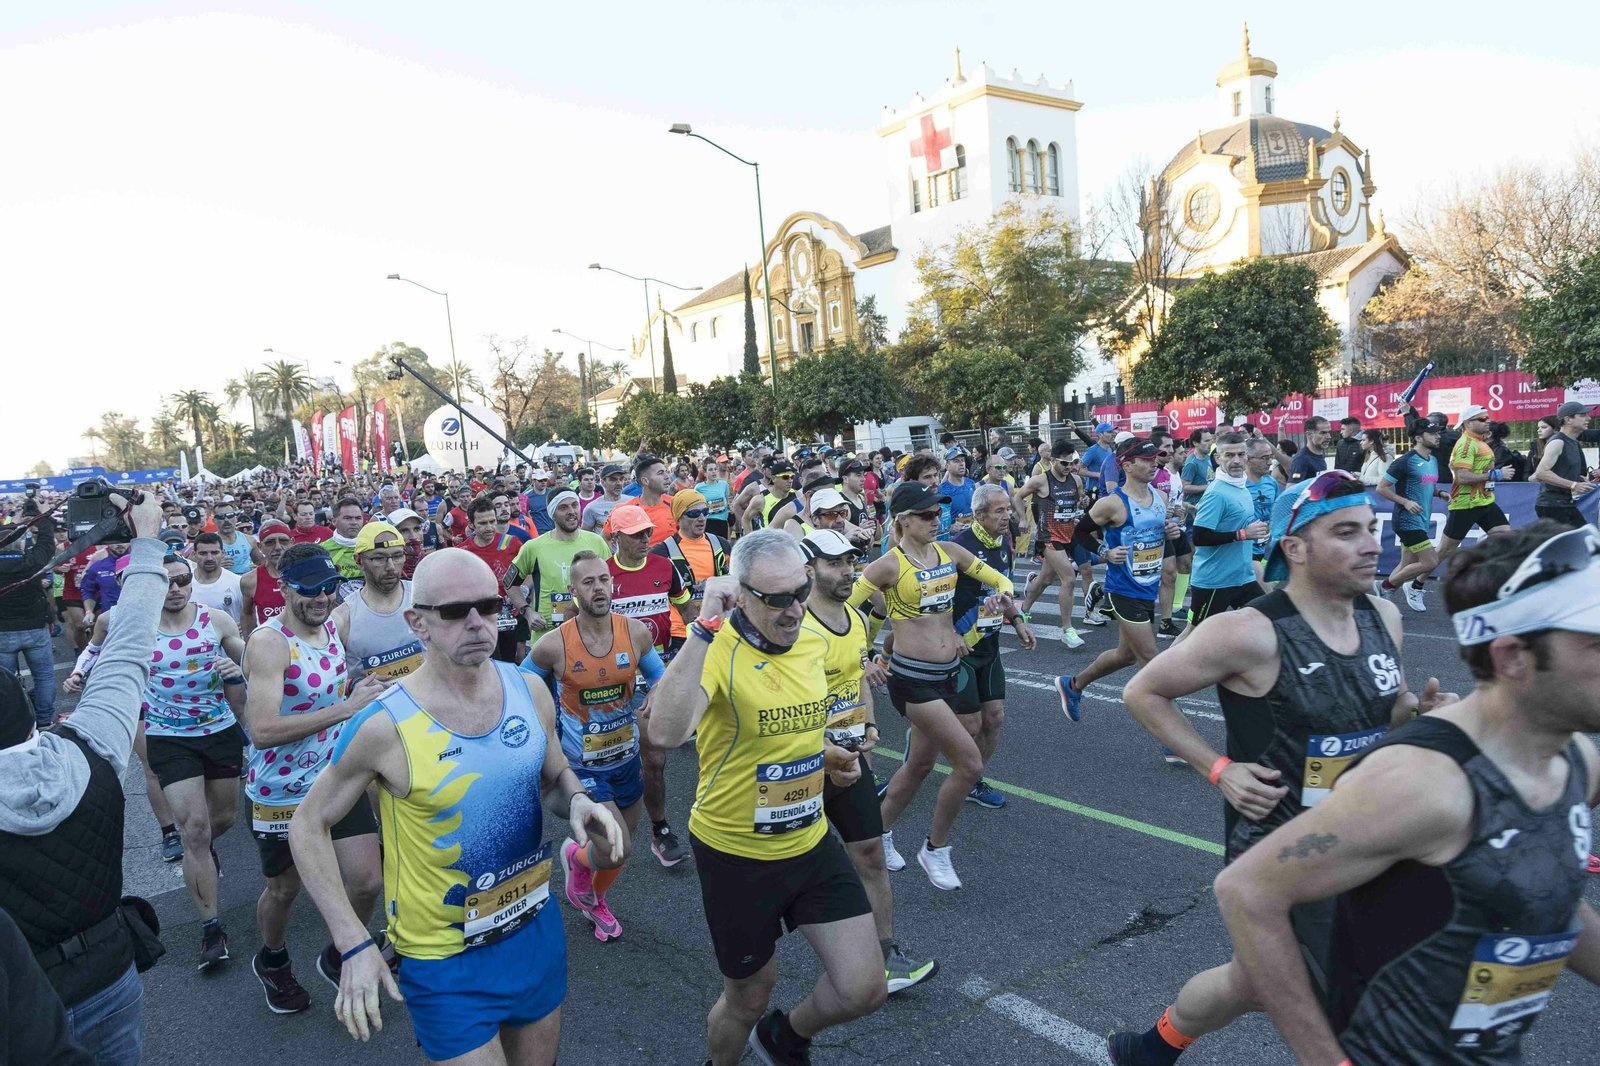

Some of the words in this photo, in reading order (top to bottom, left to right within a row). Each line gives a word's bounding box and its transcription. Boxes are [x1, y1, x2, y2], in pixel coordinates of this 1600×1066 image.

[1188, 407, 1207, 418] IMD
[431, 441, 479, 450] ZURICH
[382, 646, 414, 663] ZURICH
[583, 686, 622, 700] Genacol
[758, 700, 830, 722] RUNNERS
[602, 717, 628, 731] ZURICH
[759, 712, 828, 736] FOREVER
[439, 747, 462, 760] poli
[597, 745, 623, 757] FEDERICO
[785, 758, 820, 776] ZURICH
[784, 787, 809, 802] 4291
[273, 810, 296, 819] 515
[770, 804, 806, 819] BUENDÍA
[808, 801, 816, 811] +3
[498, 850, 543, 881] ZURICH
[497, 883, 527, 907] 4811
[494, 899, 527, 925] OLIVIER
